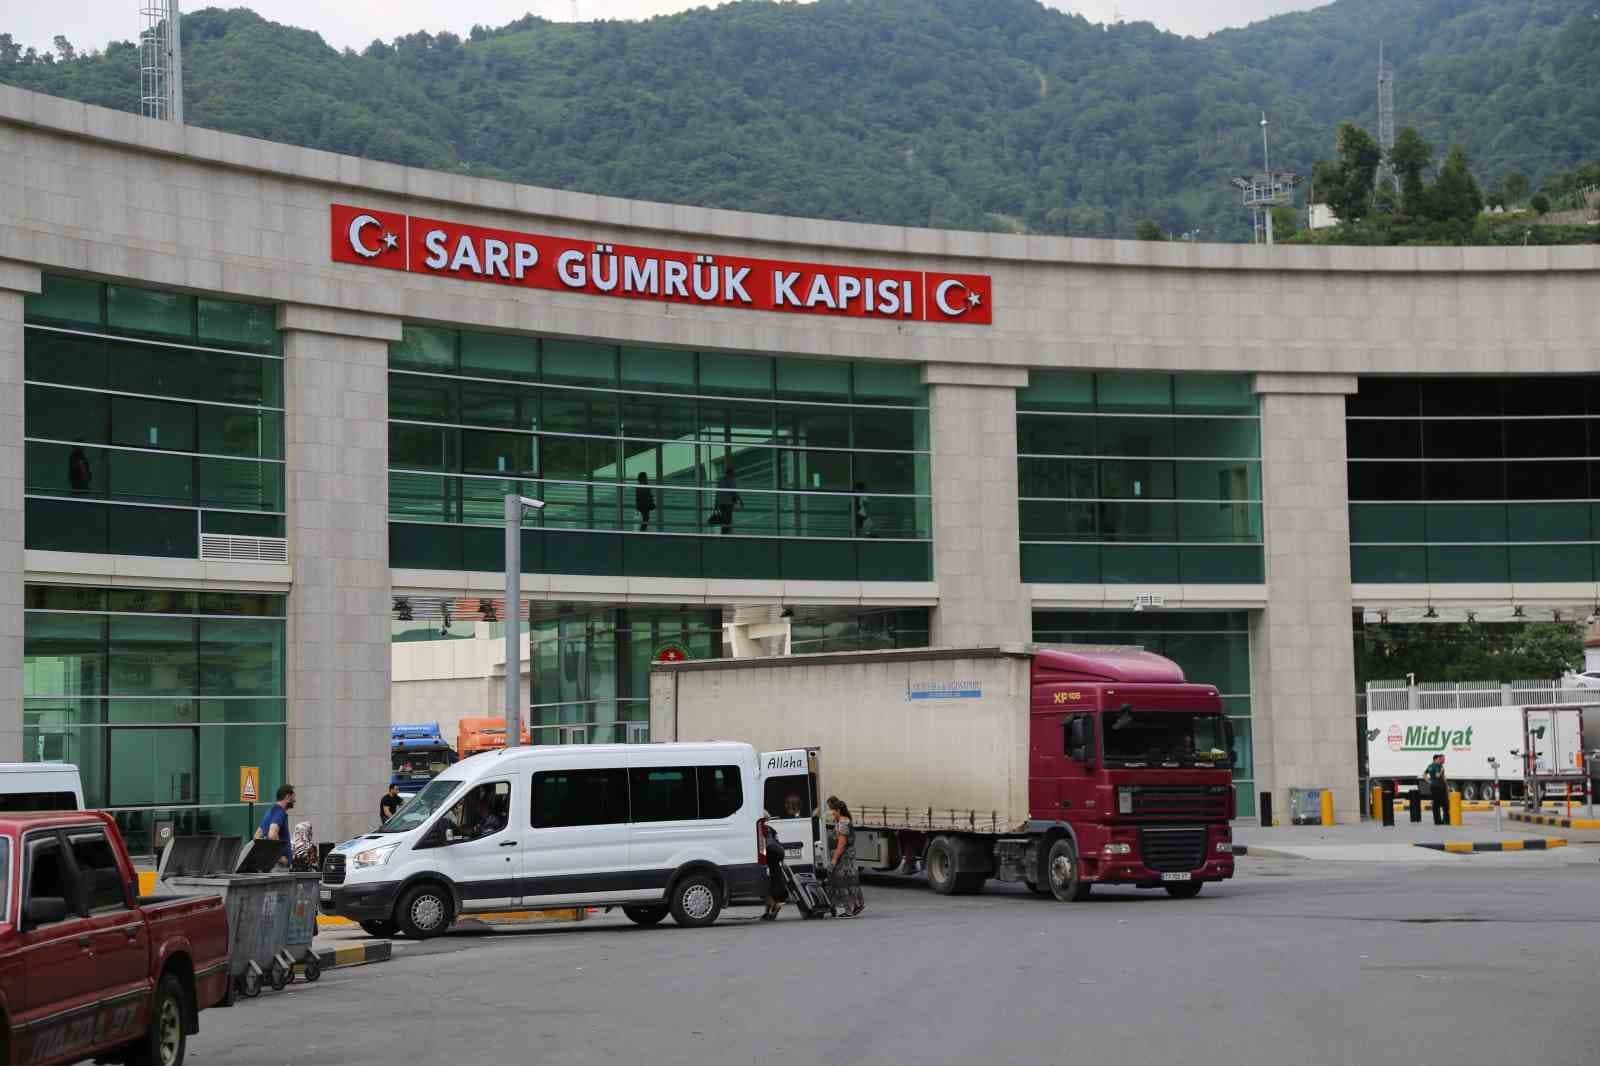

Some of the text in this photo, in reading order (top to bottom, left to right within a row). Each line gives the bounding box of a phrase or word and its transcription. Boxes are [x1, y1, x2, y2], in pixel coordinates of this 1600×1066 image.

[425, 229, 912, 314] SARP GÜMRÜK KAPISI
[1404, 725, 1473, 751] Midyat
[767, 755, 802, 769] Allaha
